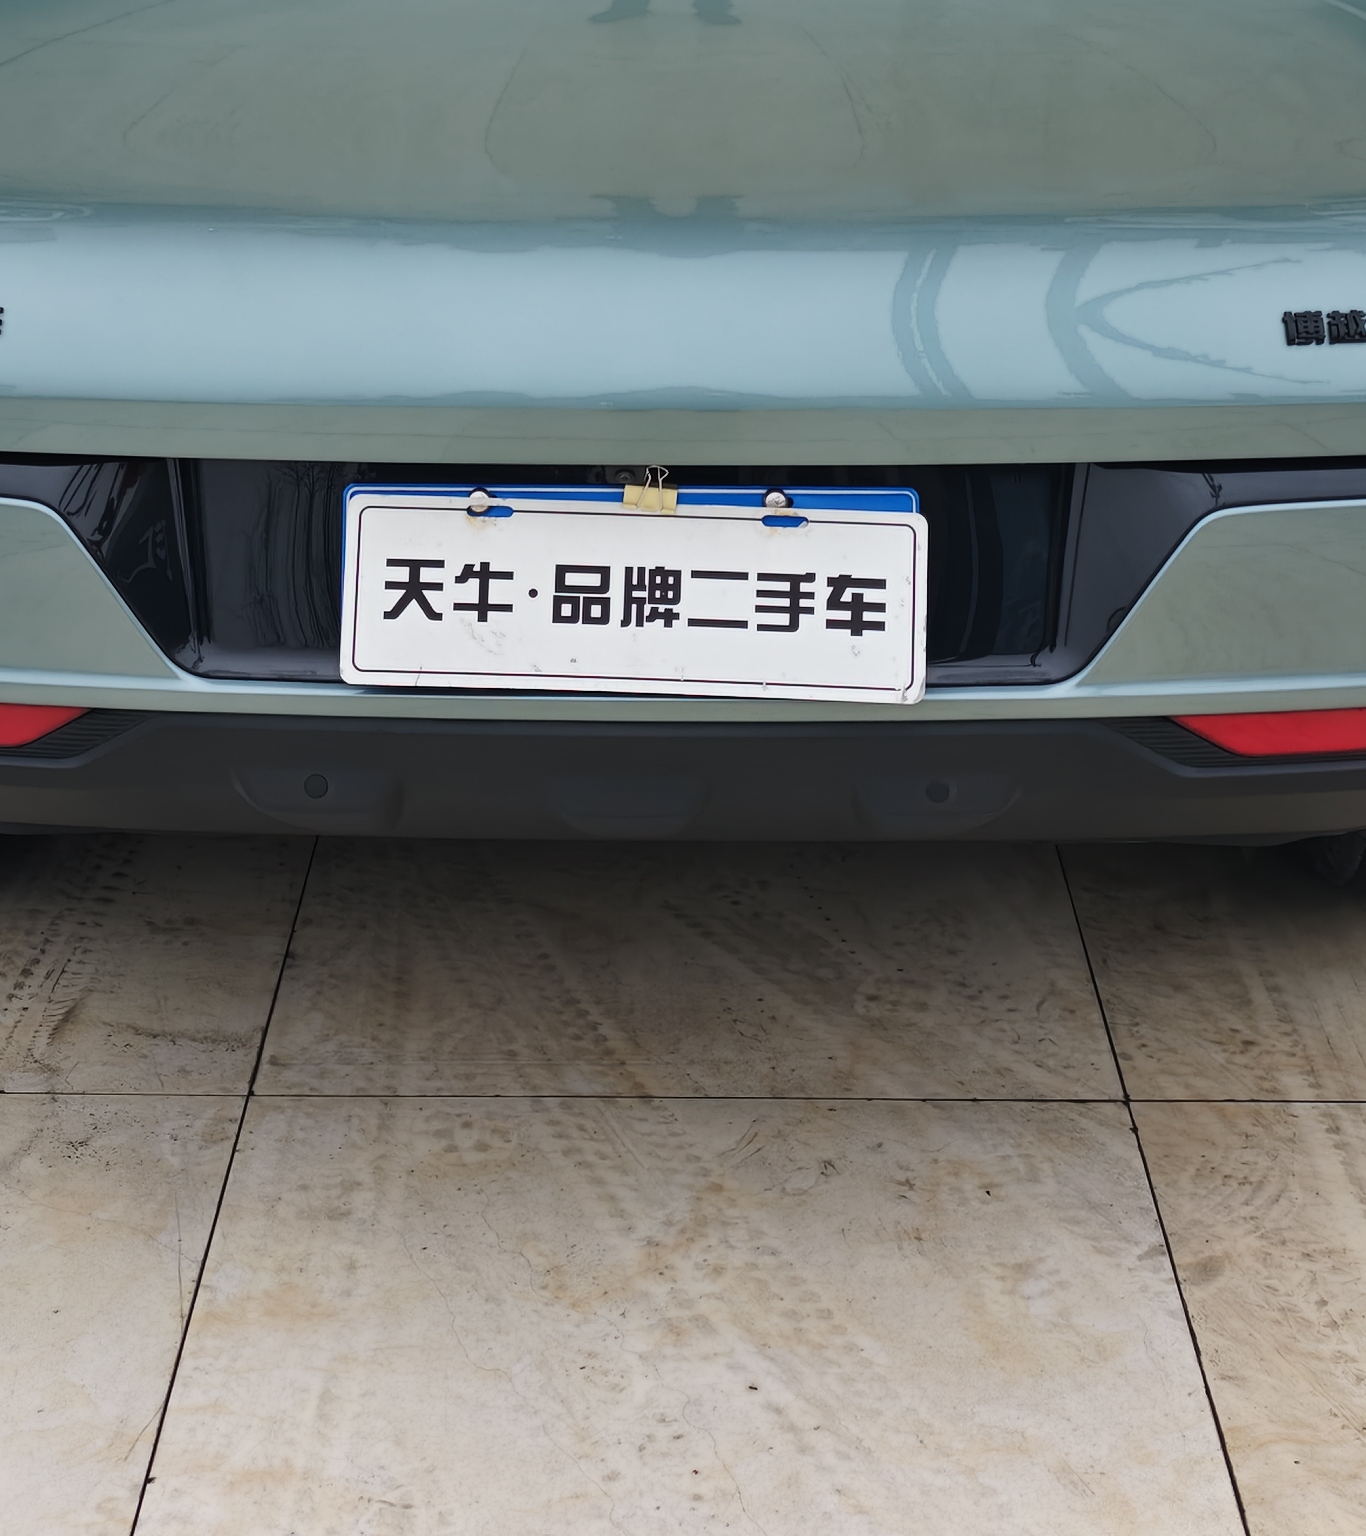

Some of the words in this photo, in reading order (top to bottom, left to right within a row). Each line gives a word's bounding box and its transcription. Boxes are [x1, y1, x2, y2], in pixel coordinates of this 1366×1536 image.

[382, 558, 888, 637] 天牛·品牌二手车
